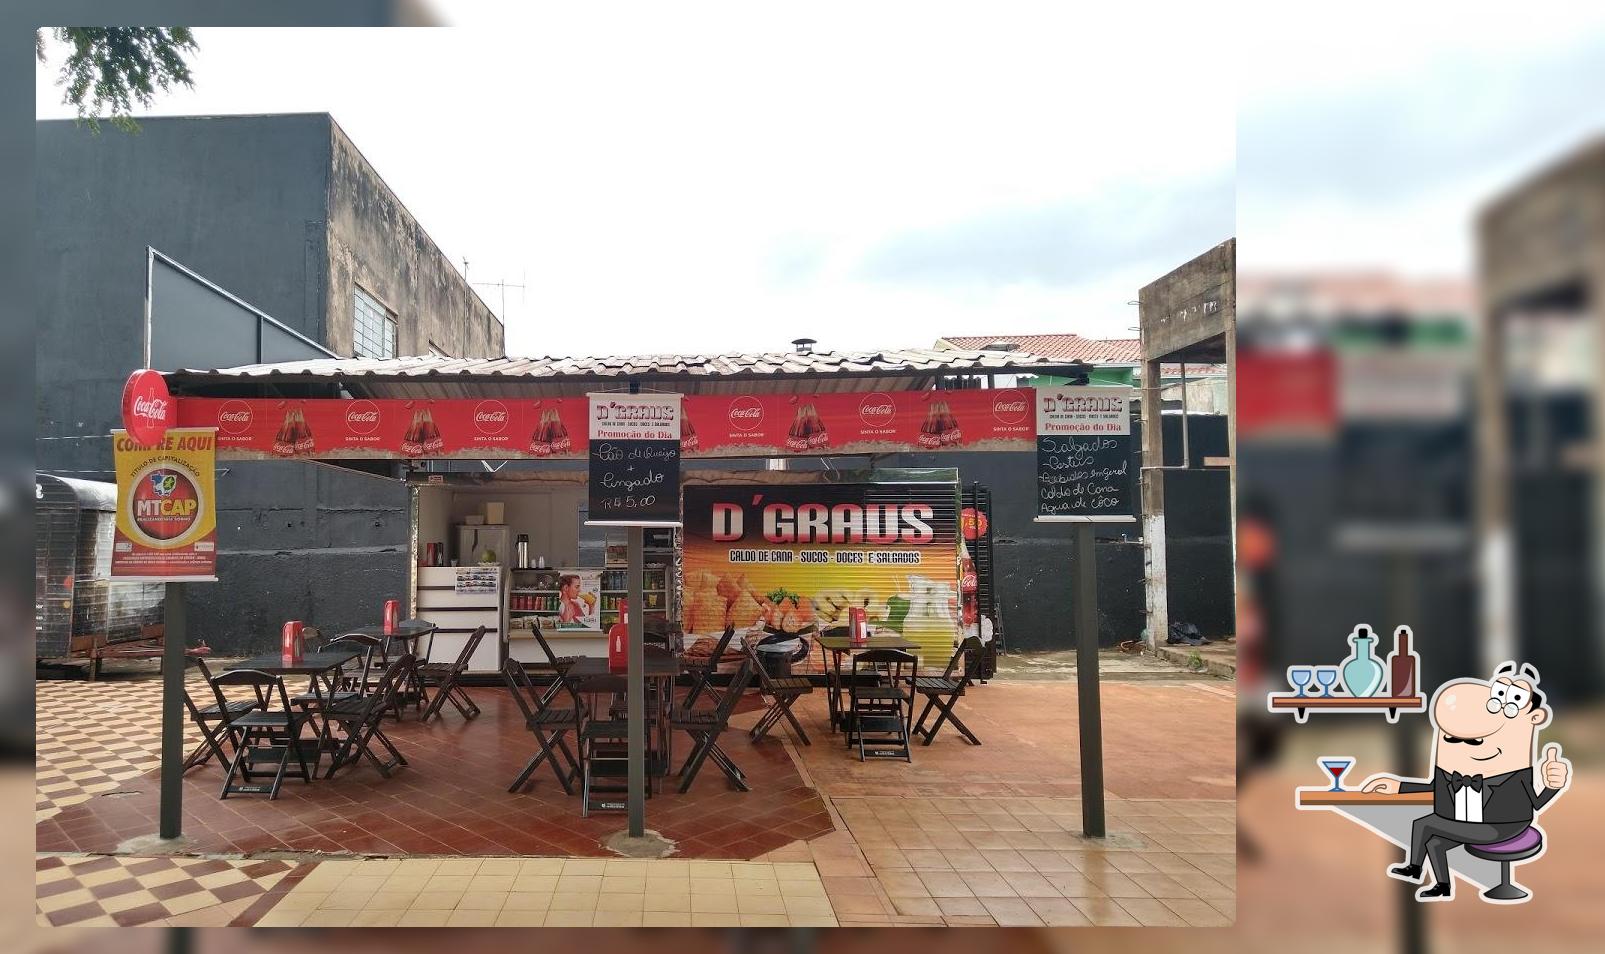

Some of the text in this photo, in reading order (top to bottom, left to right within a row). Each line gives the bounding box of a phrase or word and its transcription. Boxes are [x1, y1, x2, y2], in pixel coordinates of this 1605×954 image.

[1045, 422, 1122, 432] Promoção do Dia
[597, 430, 673, 440] Promoção do Dia
[177, 436, 213, 451] AQUI
[137, 498, 197, 516] MTCAP
[625, 495, 656, 508] 5,00
[730, 550, 756, 562] CALDO
[758, 550, 769, 562] DE
[771, 551, 793, 563] CANA
[800, 551, 828, 563] SUCOS
[836, 552, 863, 563] DOCES
[868, 552, 874, 563] E
[876, 552, 920, 564] SALGADOS
